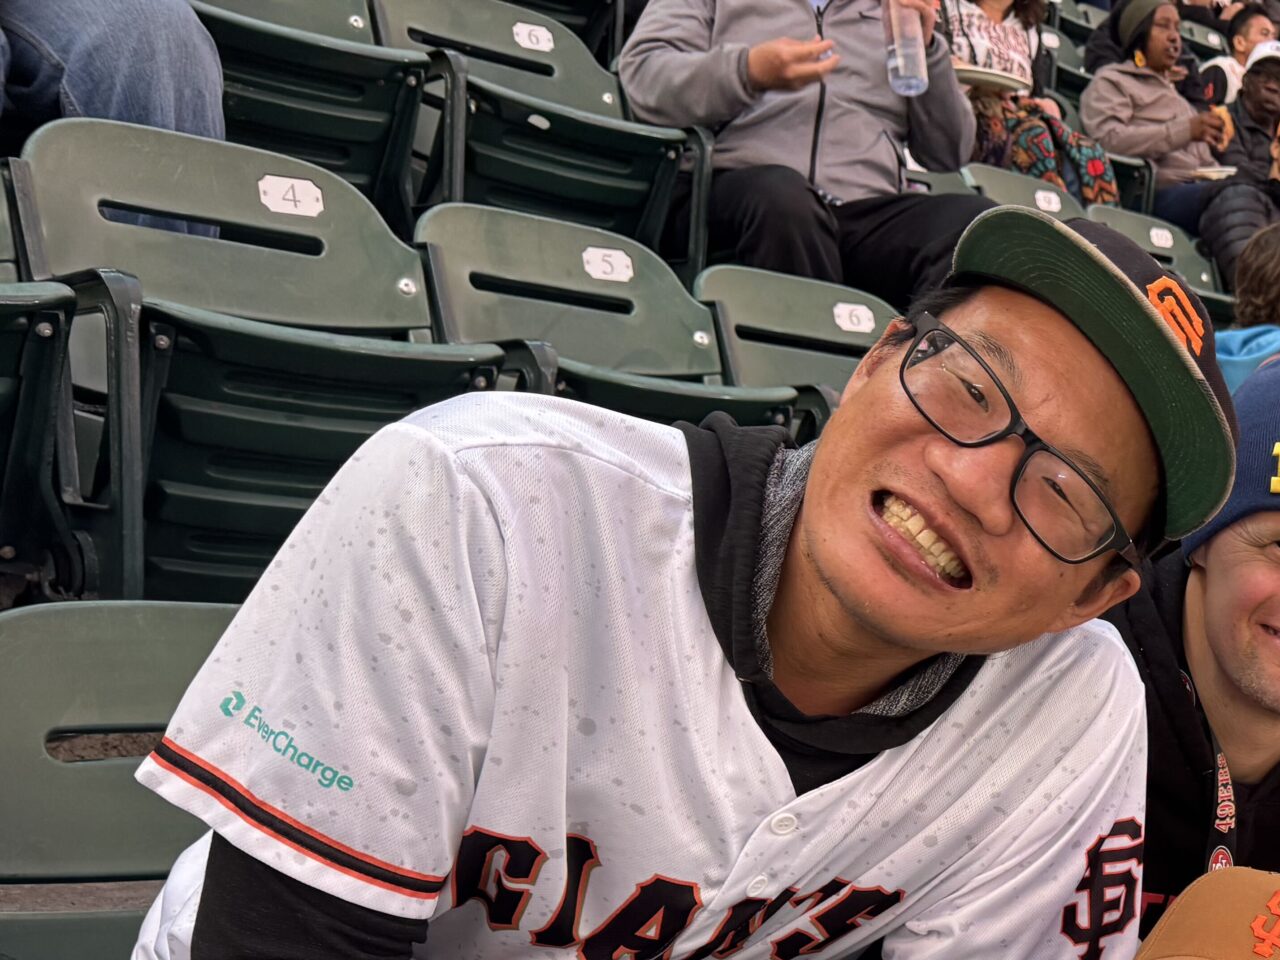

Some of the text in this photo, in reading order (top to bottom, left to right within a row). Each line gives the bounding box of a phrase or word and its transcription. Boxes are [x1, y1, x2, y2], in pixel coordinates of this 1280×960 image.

[527, 29, 540, 46] 6
[283, 182, 301, 209] 4
[602, 253, 615, 275] 5
[849, 308, 862, 331] 6
[243, 705, 355, 793] EverCharge
[1214, 752, 1236, 834] 49ERS
